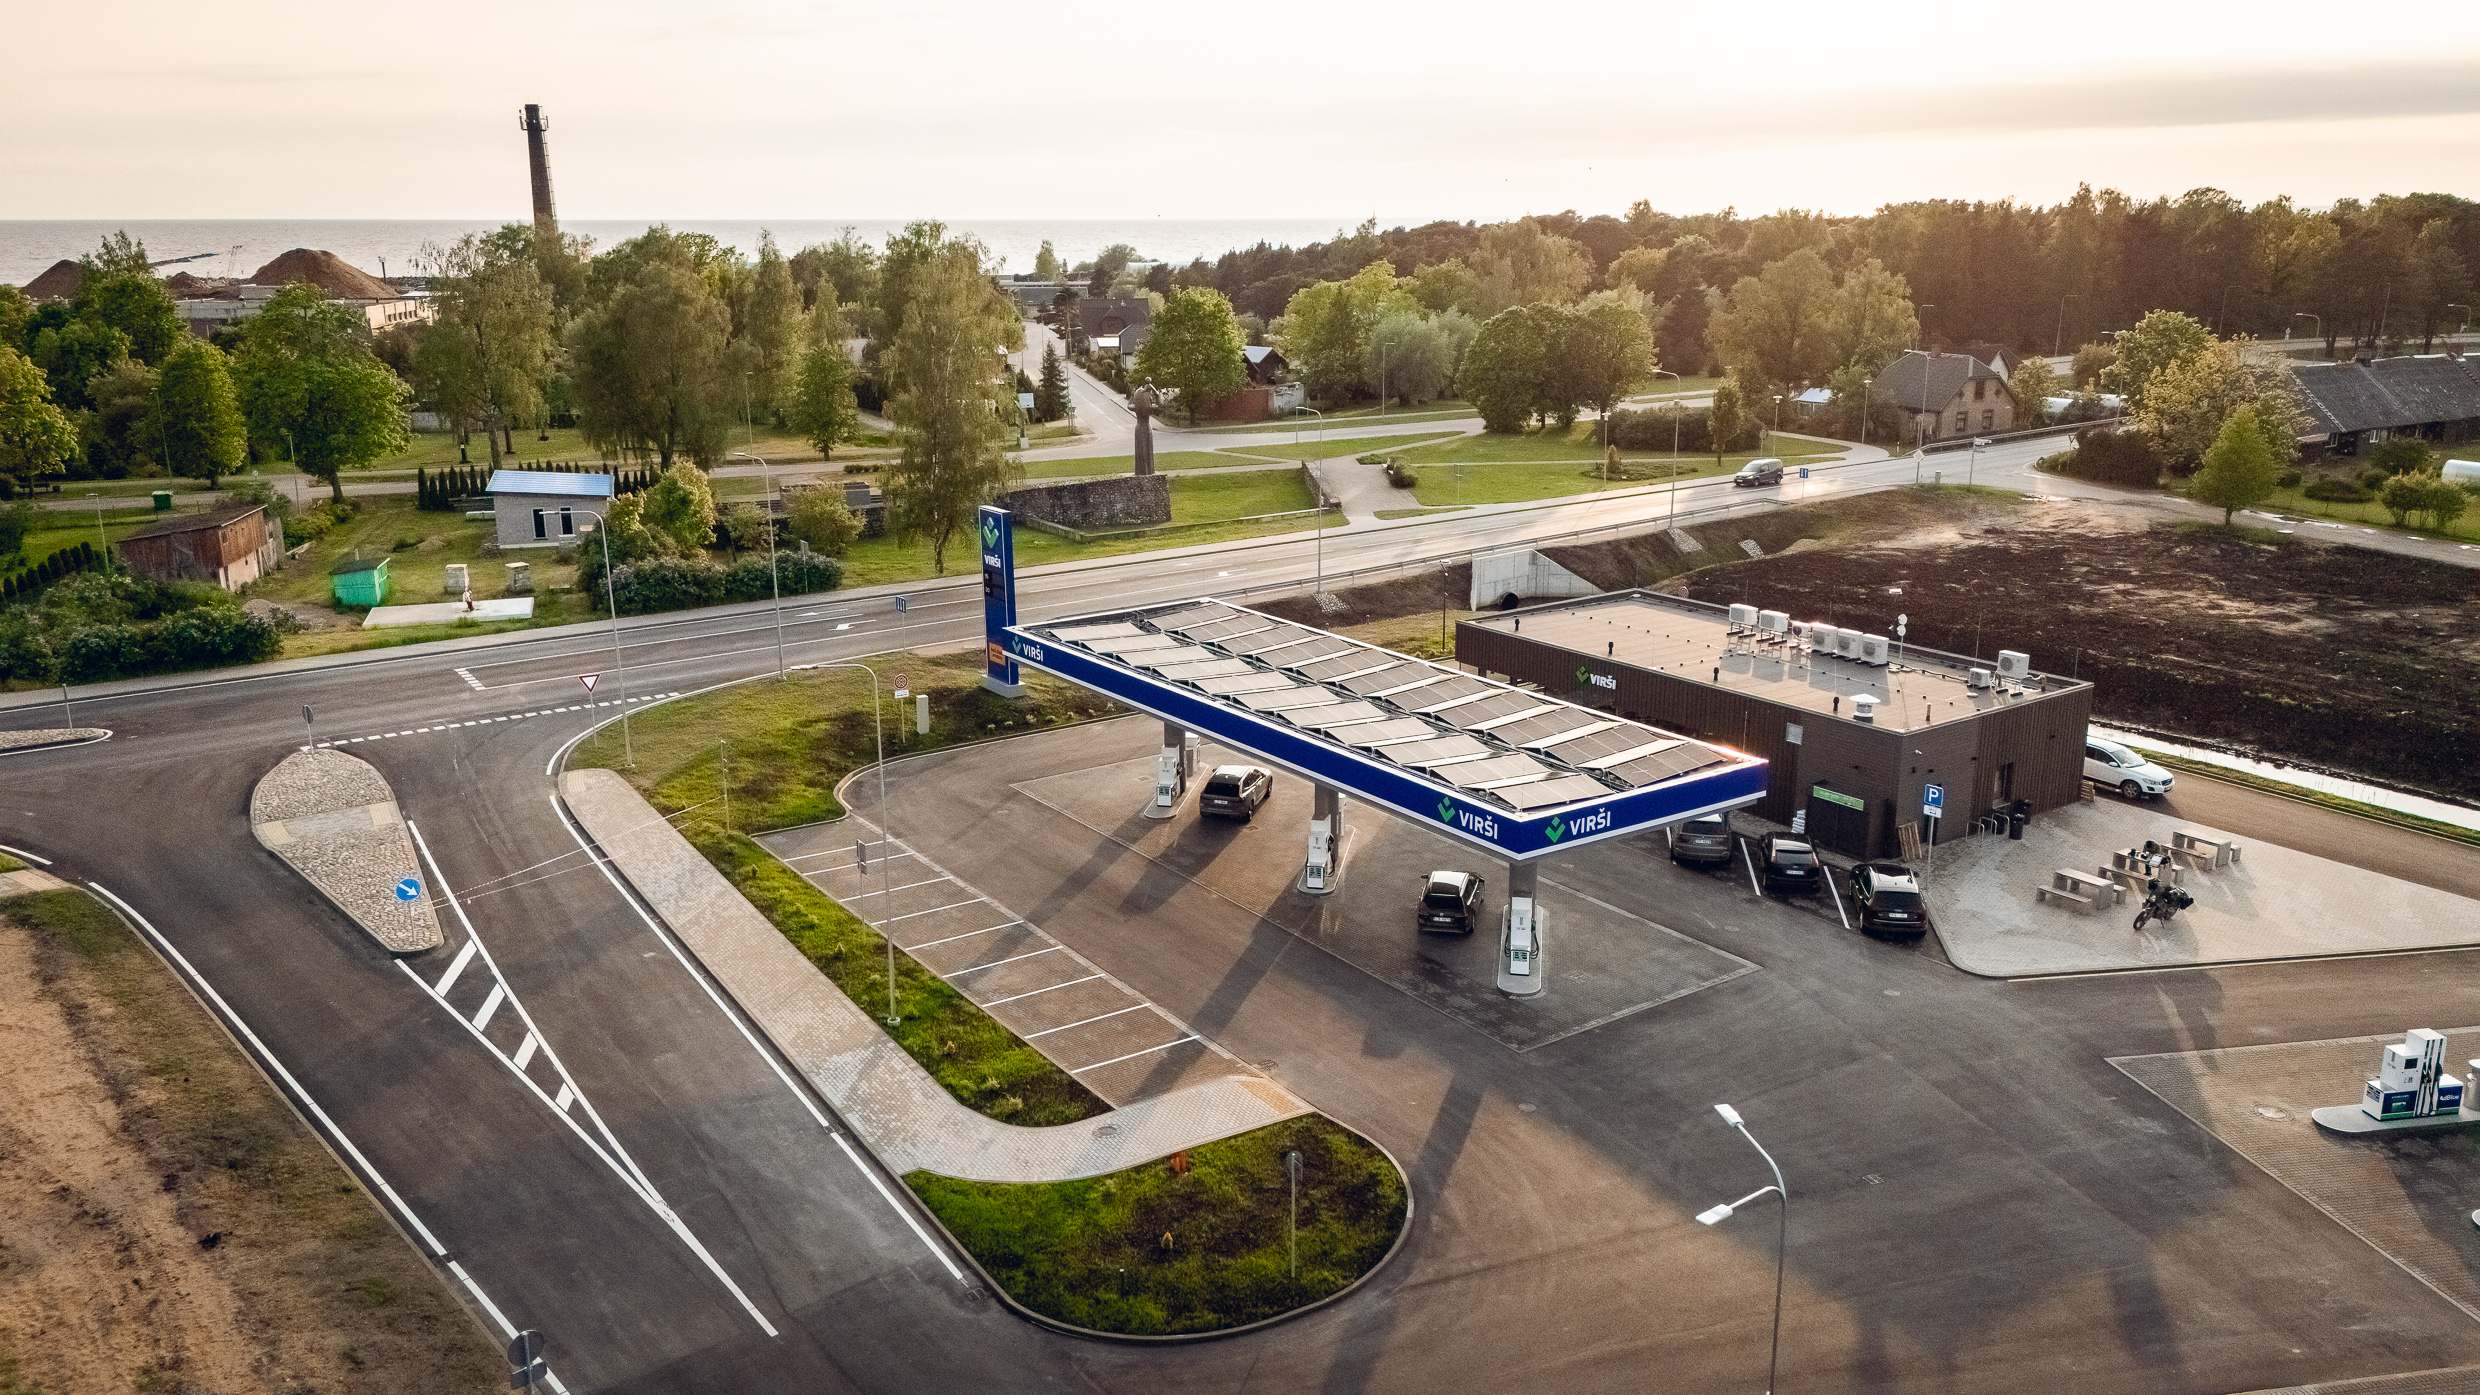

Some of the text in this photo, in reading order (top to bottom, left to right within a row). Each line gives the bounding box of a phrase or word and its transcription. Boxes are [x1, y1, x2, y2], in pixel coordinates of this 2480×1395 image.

[984, 554, 1001, 568] VIRŠI
[1023, 643, 1044, 662] VIRŠI
[1590, 673, 1617, 690] VIRŠI
[1929, 787, 1939, 802] P
[1459, 809, 1498, 840] VIRŠI
[1570, 807, 1612, 836] VIRŠI
